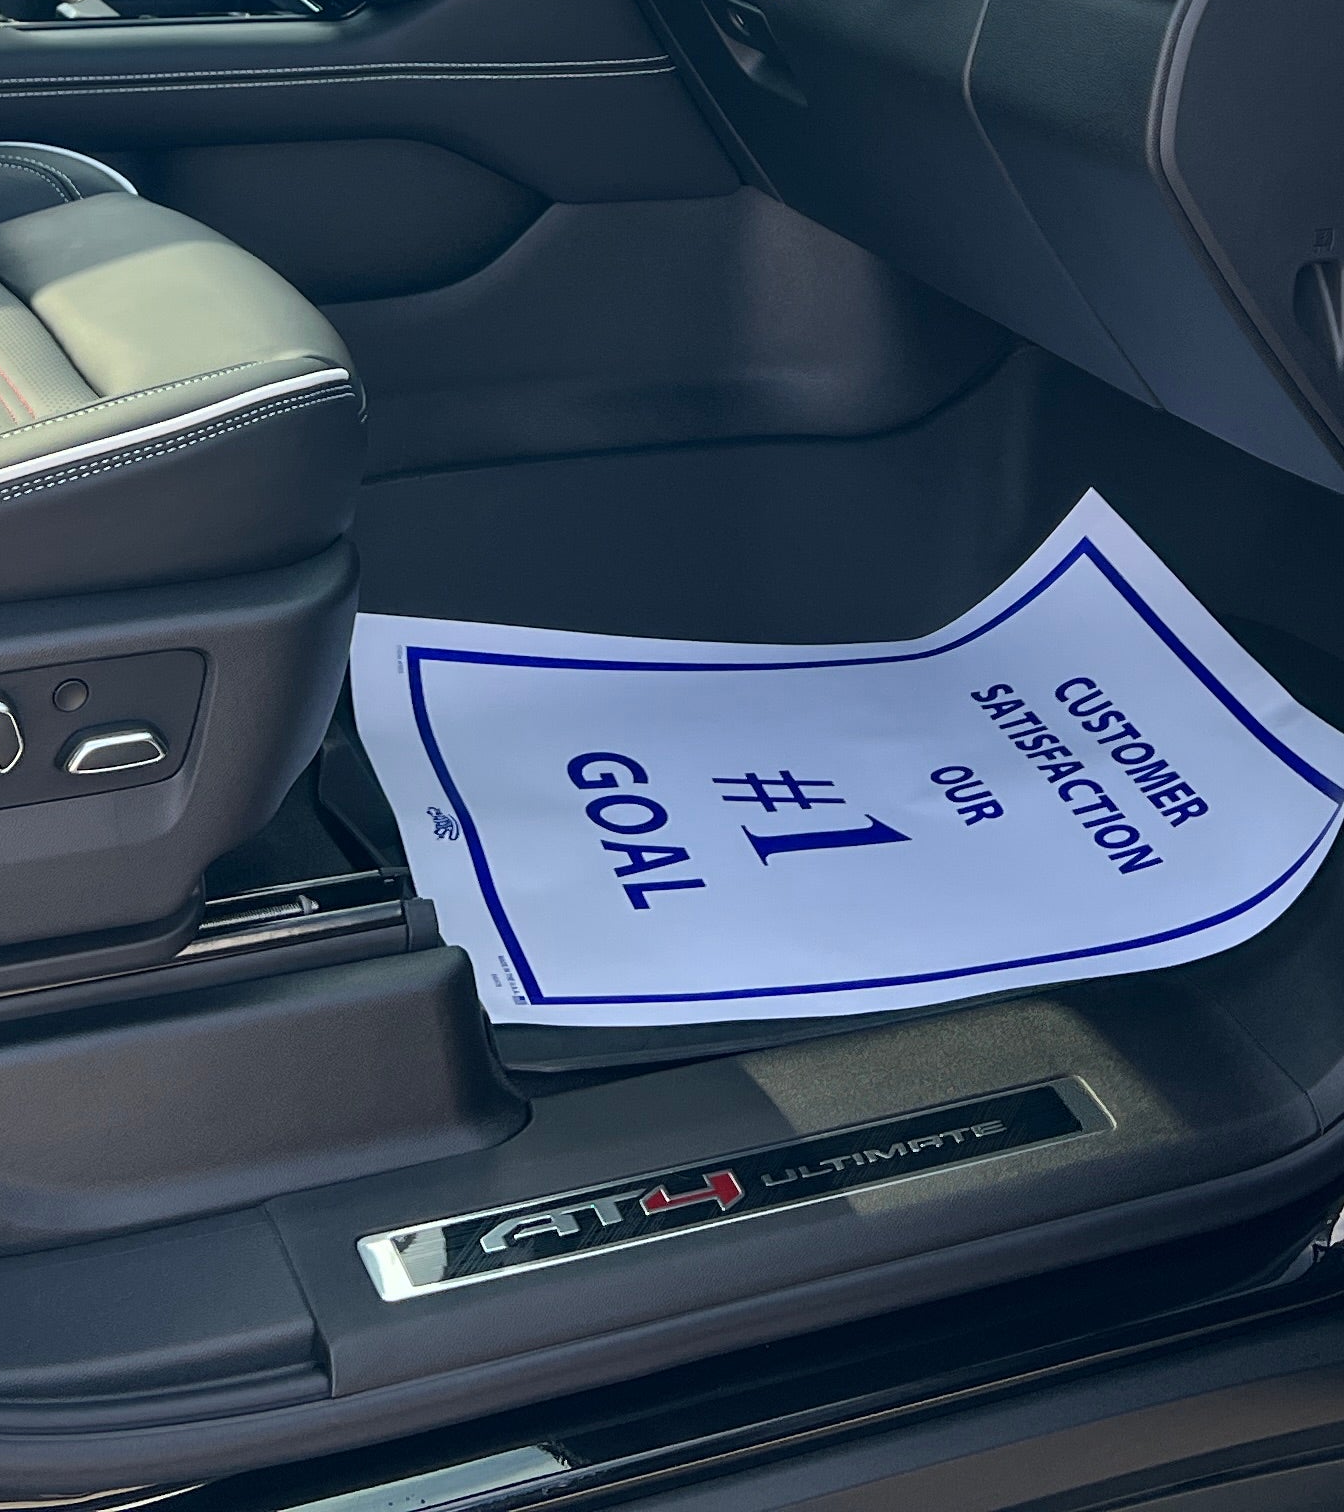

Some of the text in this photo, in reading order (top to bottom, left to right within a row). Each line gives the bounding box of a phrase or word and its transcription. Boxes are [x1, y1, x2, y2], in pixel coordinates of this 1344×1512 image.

[711, 769, 913, 867] #1
[930, 765, 1005, 827] OUR
[969, 683, 1164, 875] SATISFACTION
[1054, 676, 1209, 828] CUSTOMER
[566, 751, 707, 911] GOAL
[479, 1119, 1007, 1253] AT4 ULTIMATE
